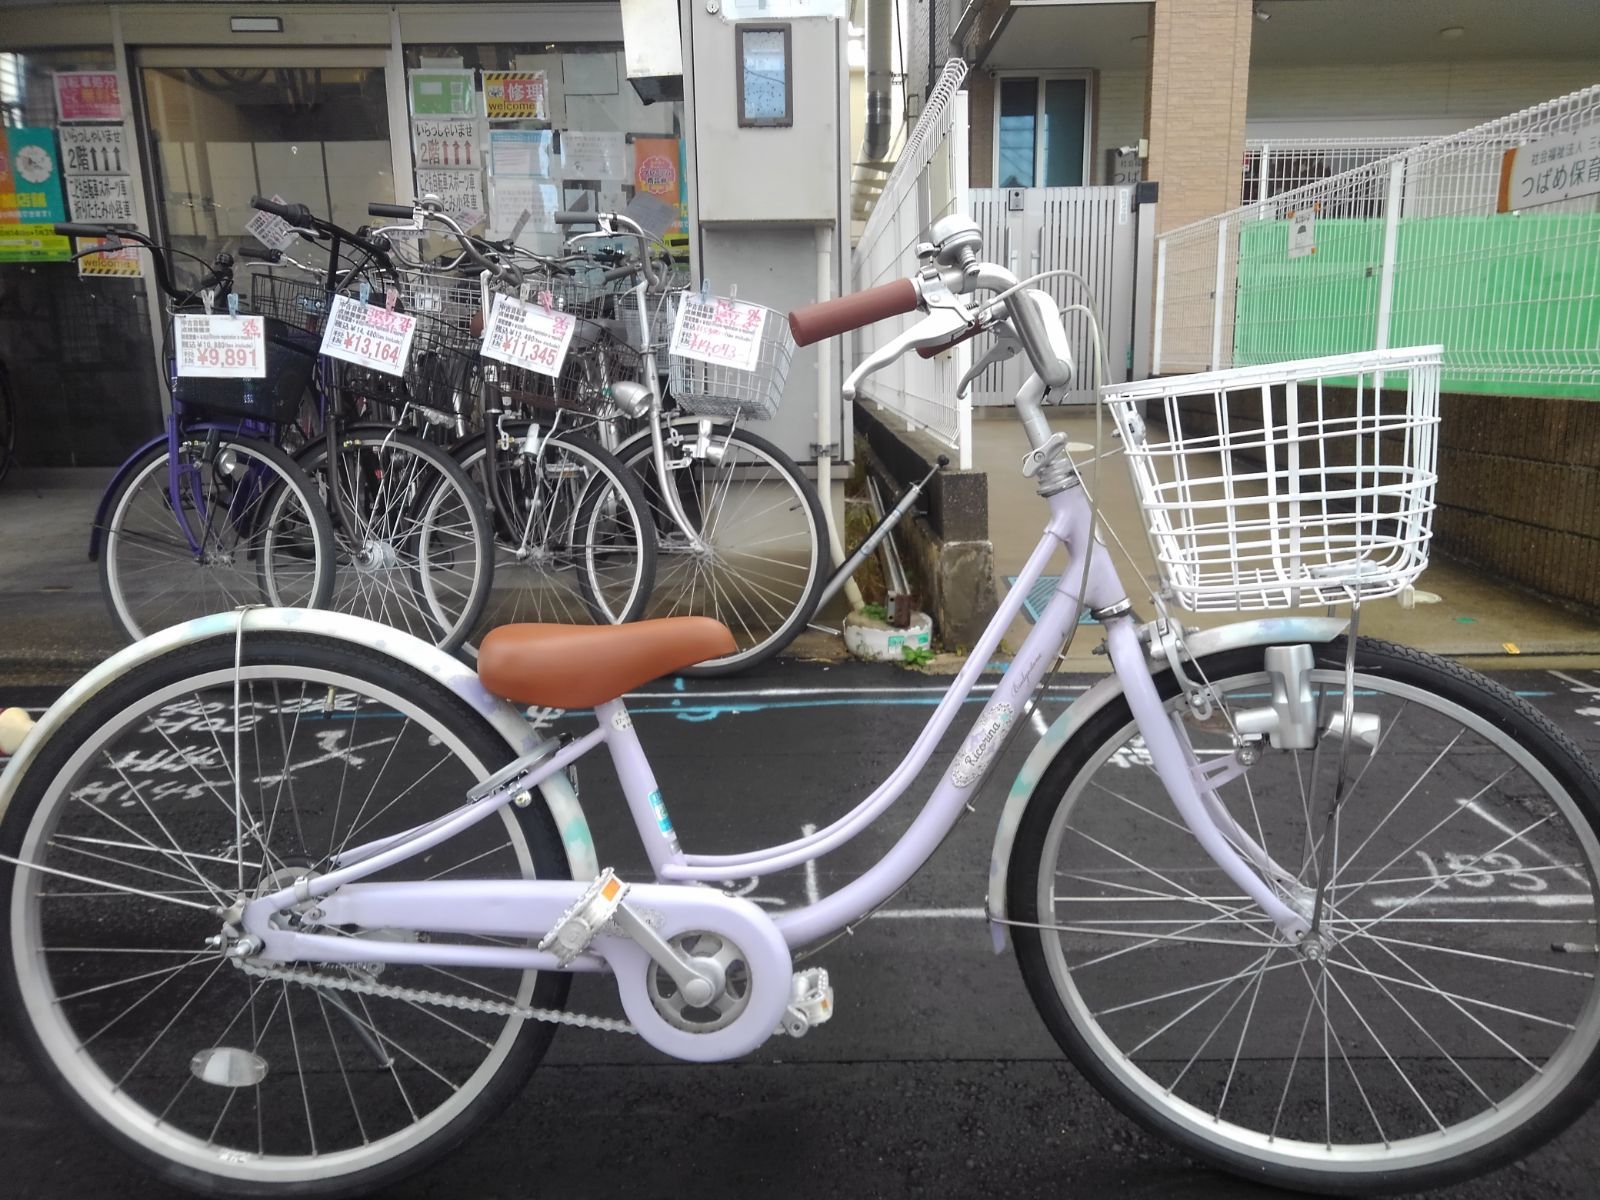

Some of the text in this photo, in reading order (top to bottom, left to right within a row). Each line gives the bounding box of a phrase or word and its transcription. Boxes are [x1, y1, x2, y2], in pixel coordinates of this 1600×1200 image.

[508, 82, 544, 101] 修理
[62, 128, 122, 143] いらっしゃいませ
[416, 123, 473, 138] いらっしゃいませ
[68, 146, 90, 171] 2階
[420, 140, 441, 165] 2階
[1531, 142, 1582, 166] 社会福祉法人
[1521, 156, 1600, 198] つばめ保育
[197, 348, 257, 368] ¥9,891
[343, 332, 400, 364] ¥13,164
[501, 333, 557, 366] ¥11,345
[964, 721, 1001, 767] Ricorina
